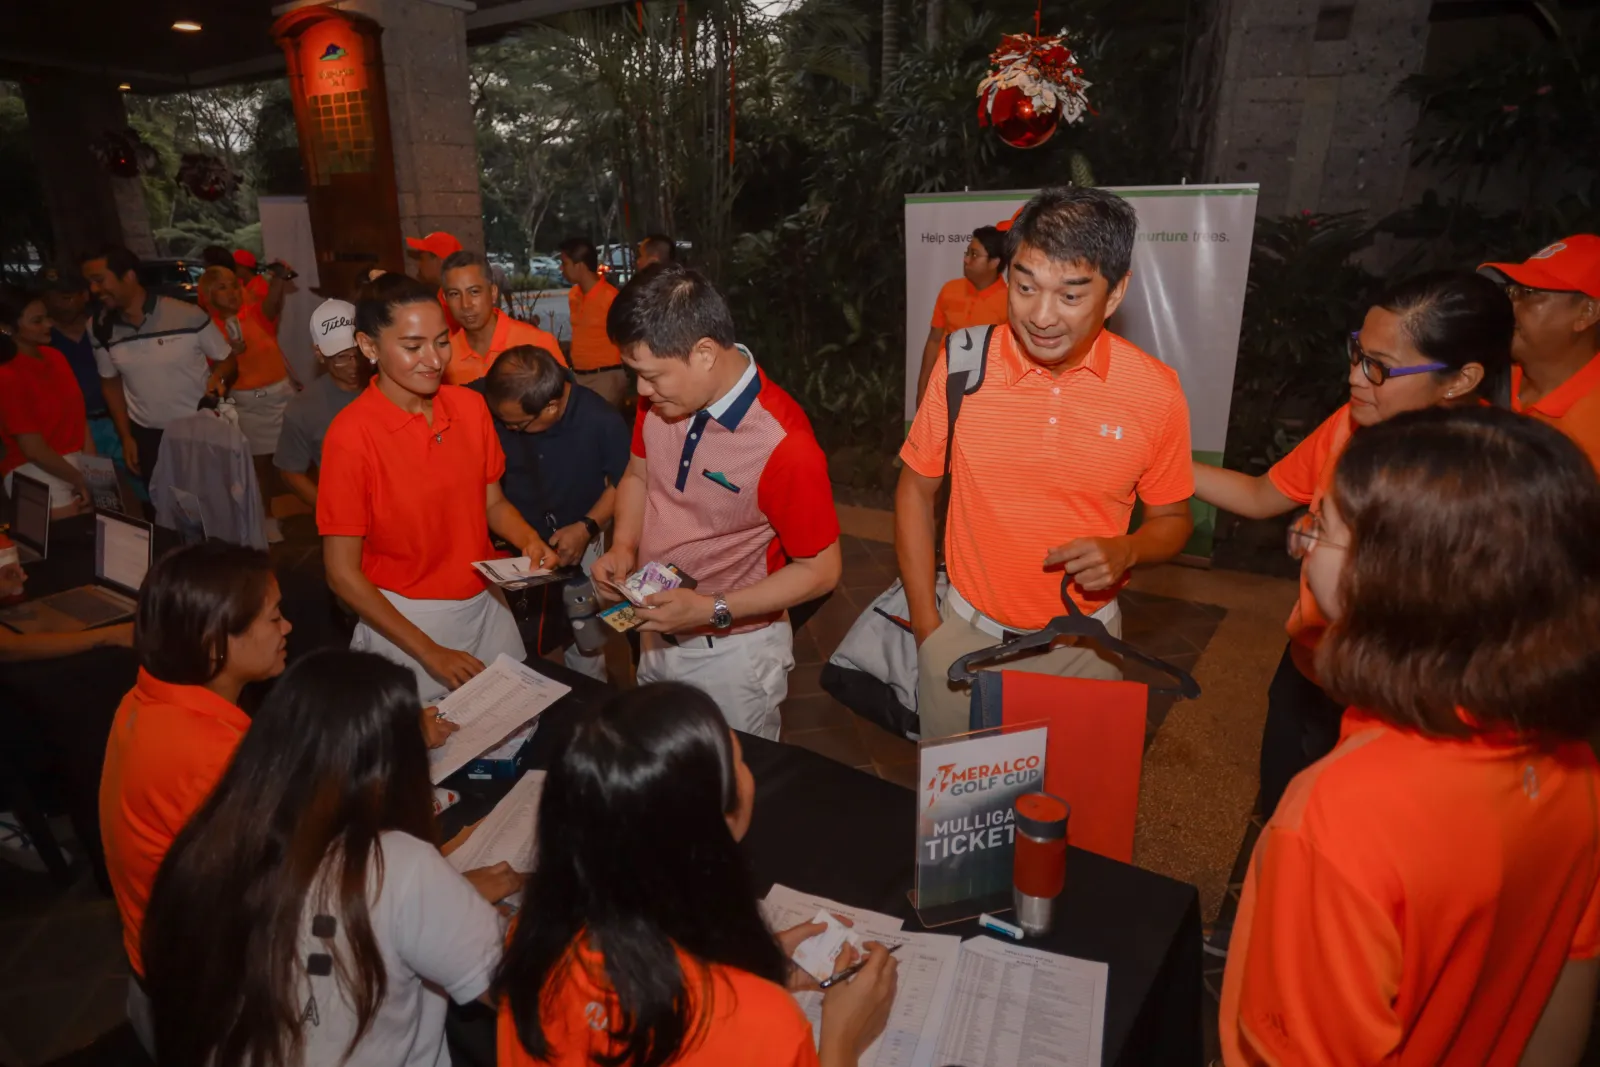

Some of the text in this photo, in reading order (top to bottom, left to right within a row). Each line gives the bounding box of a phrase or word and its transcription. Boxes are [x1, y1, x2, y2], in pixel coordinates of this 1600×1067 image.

[921, 232, 972, 245] Help save
[1137, 231, 1188, 242] nurture
[321, 316, 353, 336] Titlei
[950, 769, 1040, 796] GOLF CUP
[952, 756, 1040, 783] MERALCO
[933, 808, 1015, 837] MULLIGA
[925, 824, 1015, 861] TICKET
